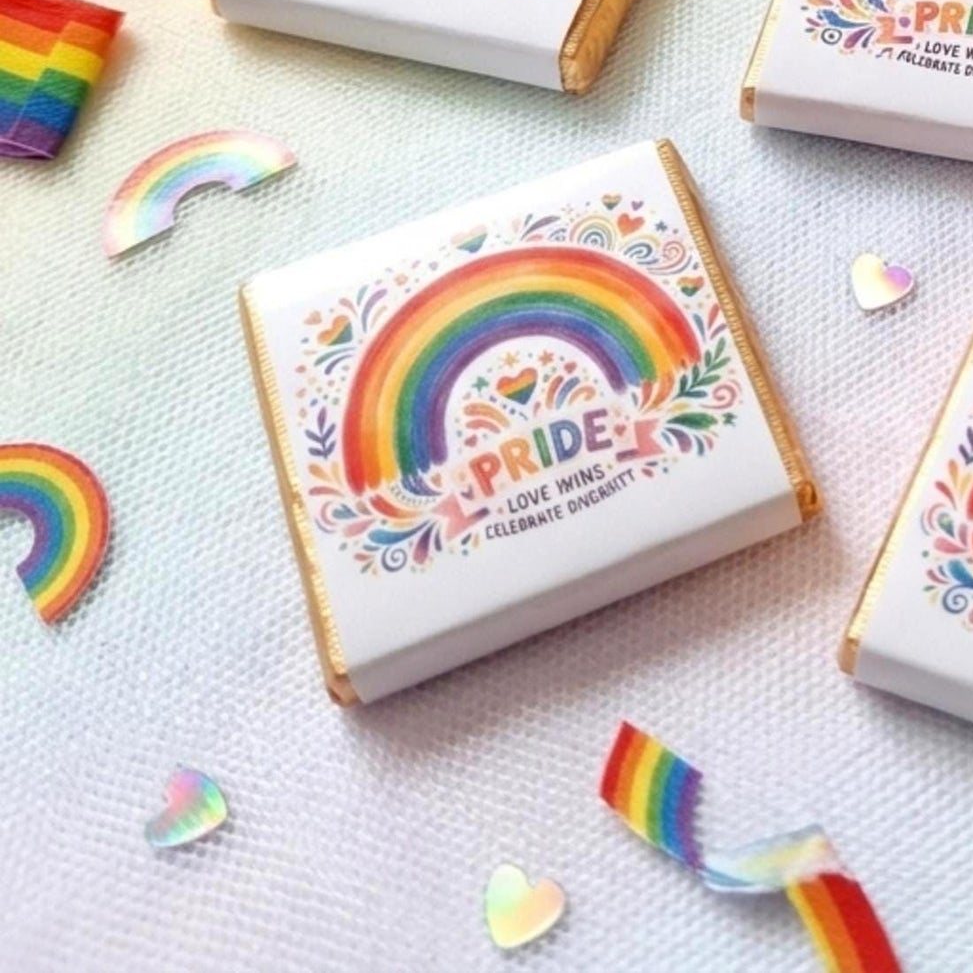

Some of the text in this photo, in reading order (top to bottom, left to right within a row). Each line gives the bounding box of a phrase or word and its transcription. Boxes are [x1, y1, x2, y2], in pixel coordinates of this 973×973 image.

[924, 40, 961, 58] LOVE
[469, 408, 613, 497] PRIDE
[506, 462, 606, 514] LOVE WINS
